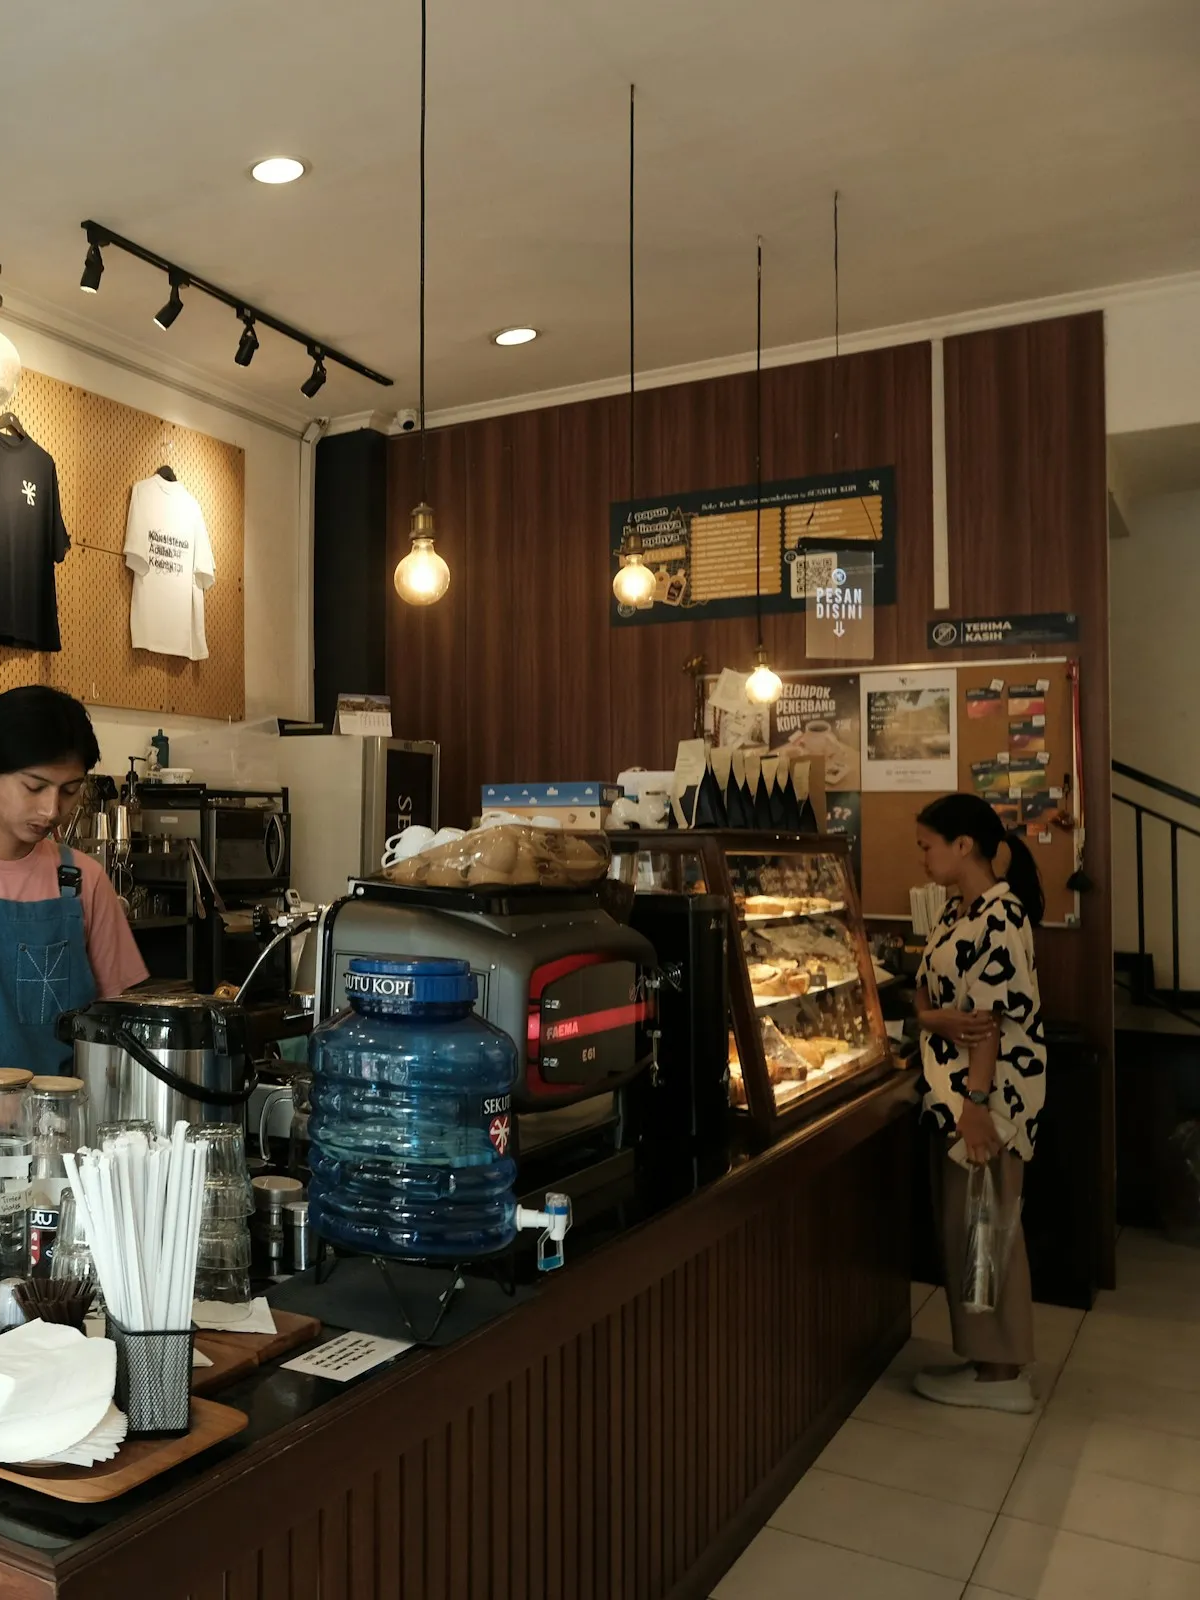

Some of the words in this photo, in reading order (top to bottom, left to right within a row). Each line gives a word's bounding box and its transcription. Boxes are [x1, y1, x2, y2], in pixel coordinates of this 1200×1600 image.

[816, 587, 862, 604] PESAN
[816, 603, 862, 620] DISINI
[965, 621, 1012, 632] TERIMA
[965, 631, 1003, 642] KASIH
[776, 715, 801, 732] KOPI
[372, 977, 411, 996] KOPI
[546, 1021, 579, 1040] FAEMA
